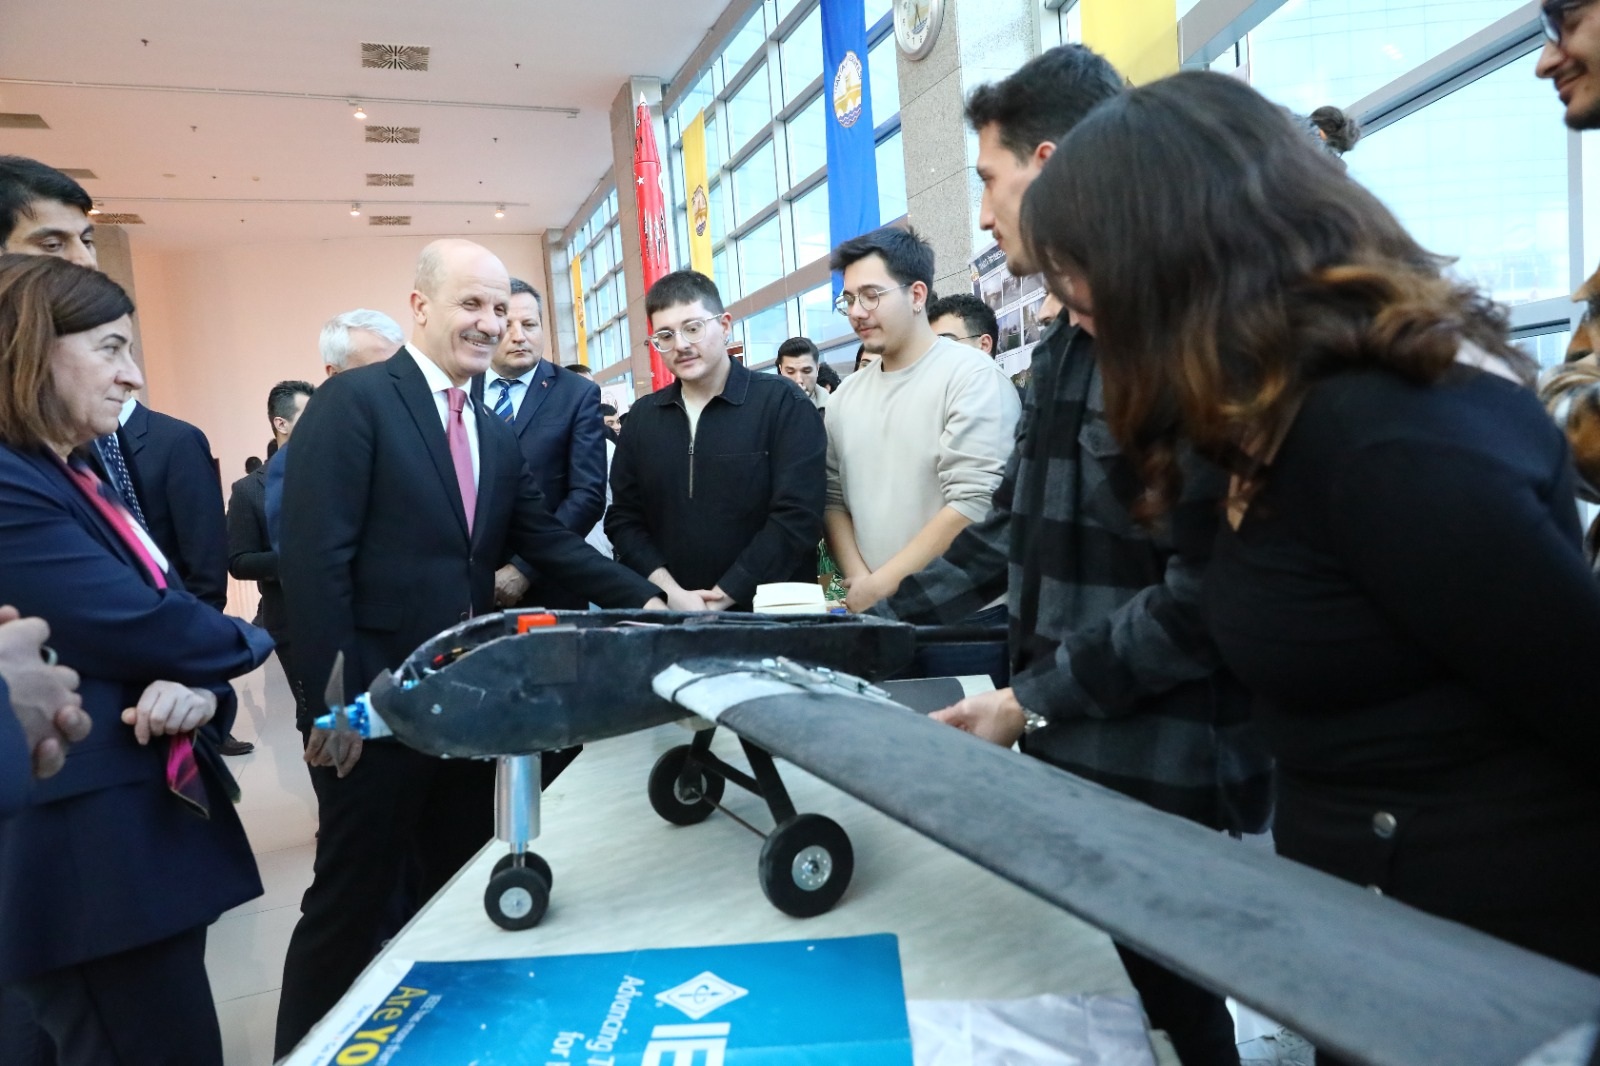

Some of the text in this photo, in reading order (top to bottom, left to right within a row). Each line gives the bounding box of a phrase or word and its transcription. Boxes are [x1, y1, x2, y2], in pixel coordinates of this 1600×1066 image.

[373, 986, 428, 1021] Are
[585, 974, 645, 1052] Advancing
[550, 1030, 585, 1059] for
